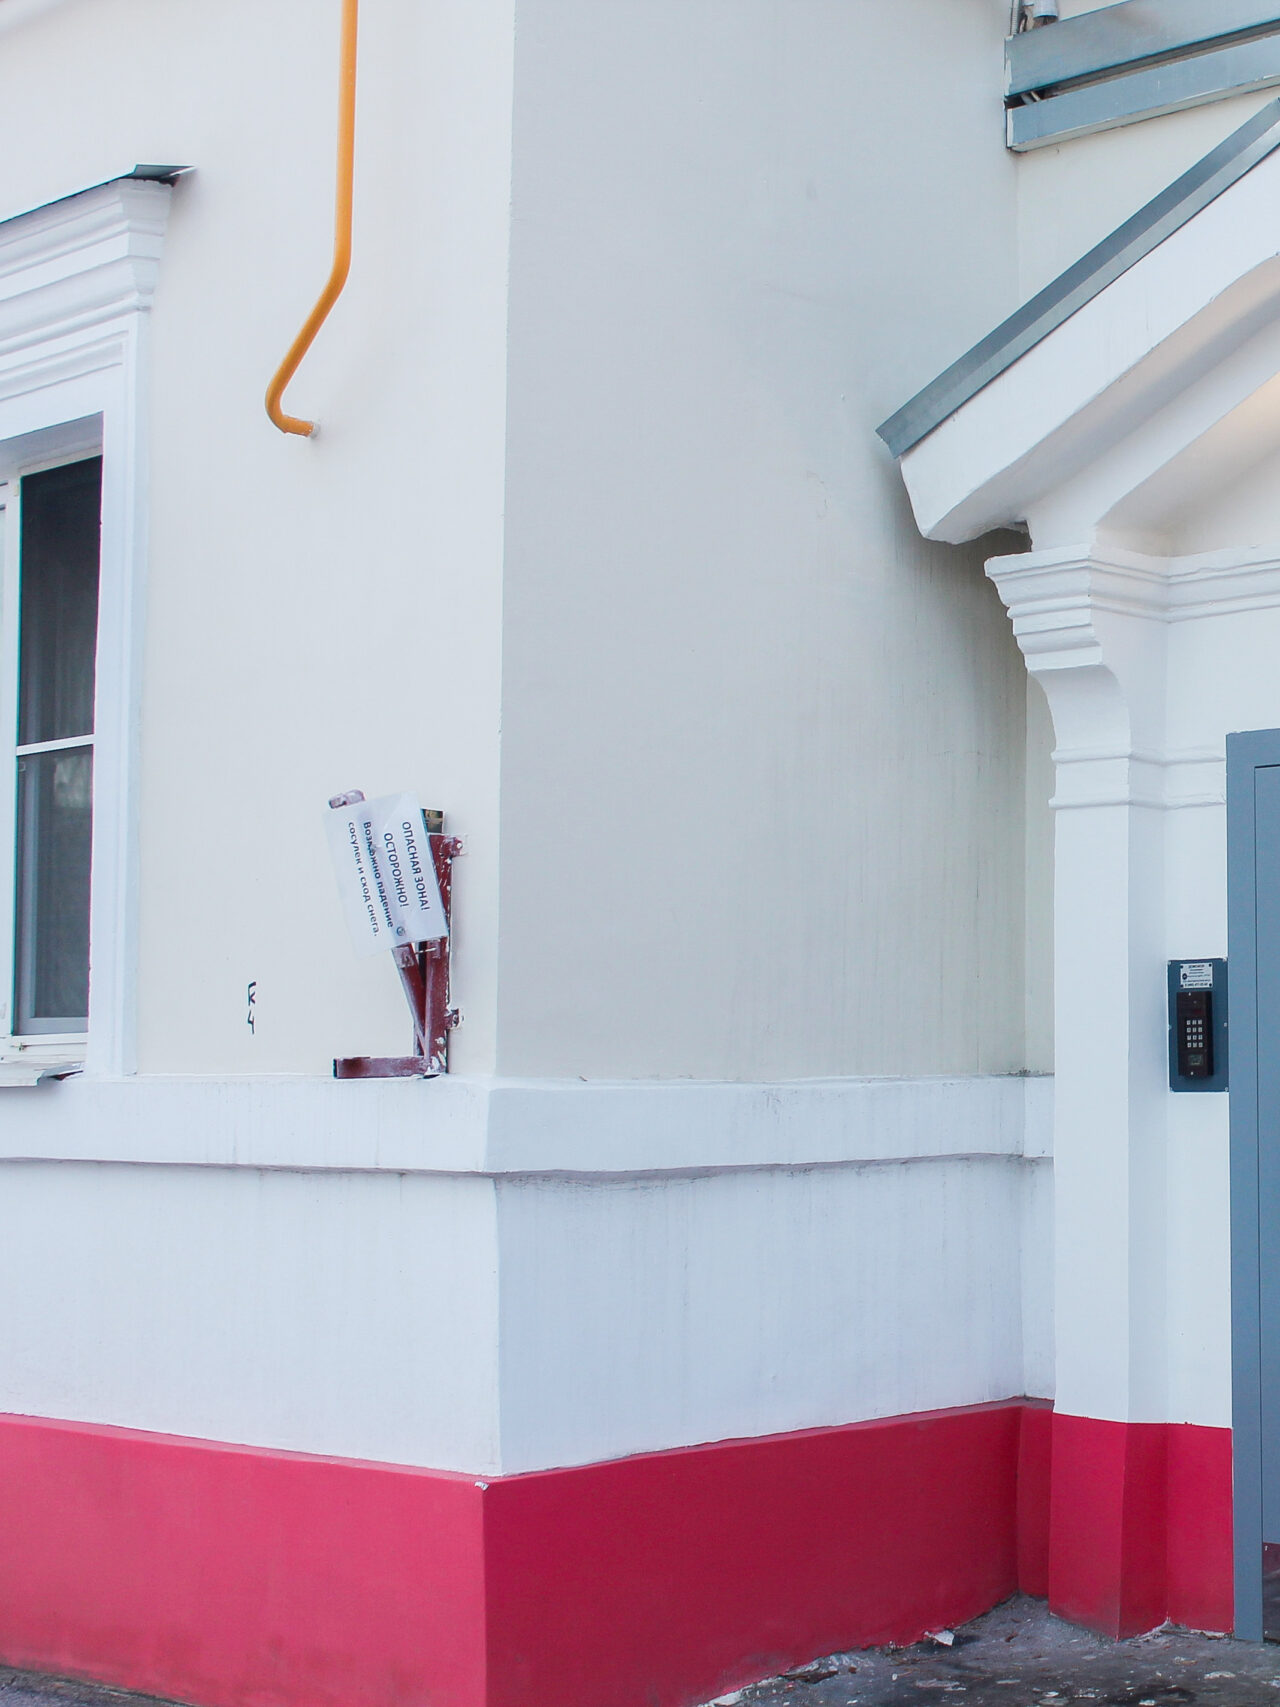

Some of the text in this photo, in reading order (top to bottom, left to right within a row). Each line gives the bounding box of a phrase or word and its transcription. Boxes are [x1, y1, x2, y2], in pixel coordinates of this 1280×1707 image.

[348, 822, 380, 937] сосулек и сход снега.
[376, 881, 393, 928] падение
[384, 832, 409, 907] ОСТОРОЖНО!
[402, 821, 430, 911] ОПАСНАЯ ЗОНА!
